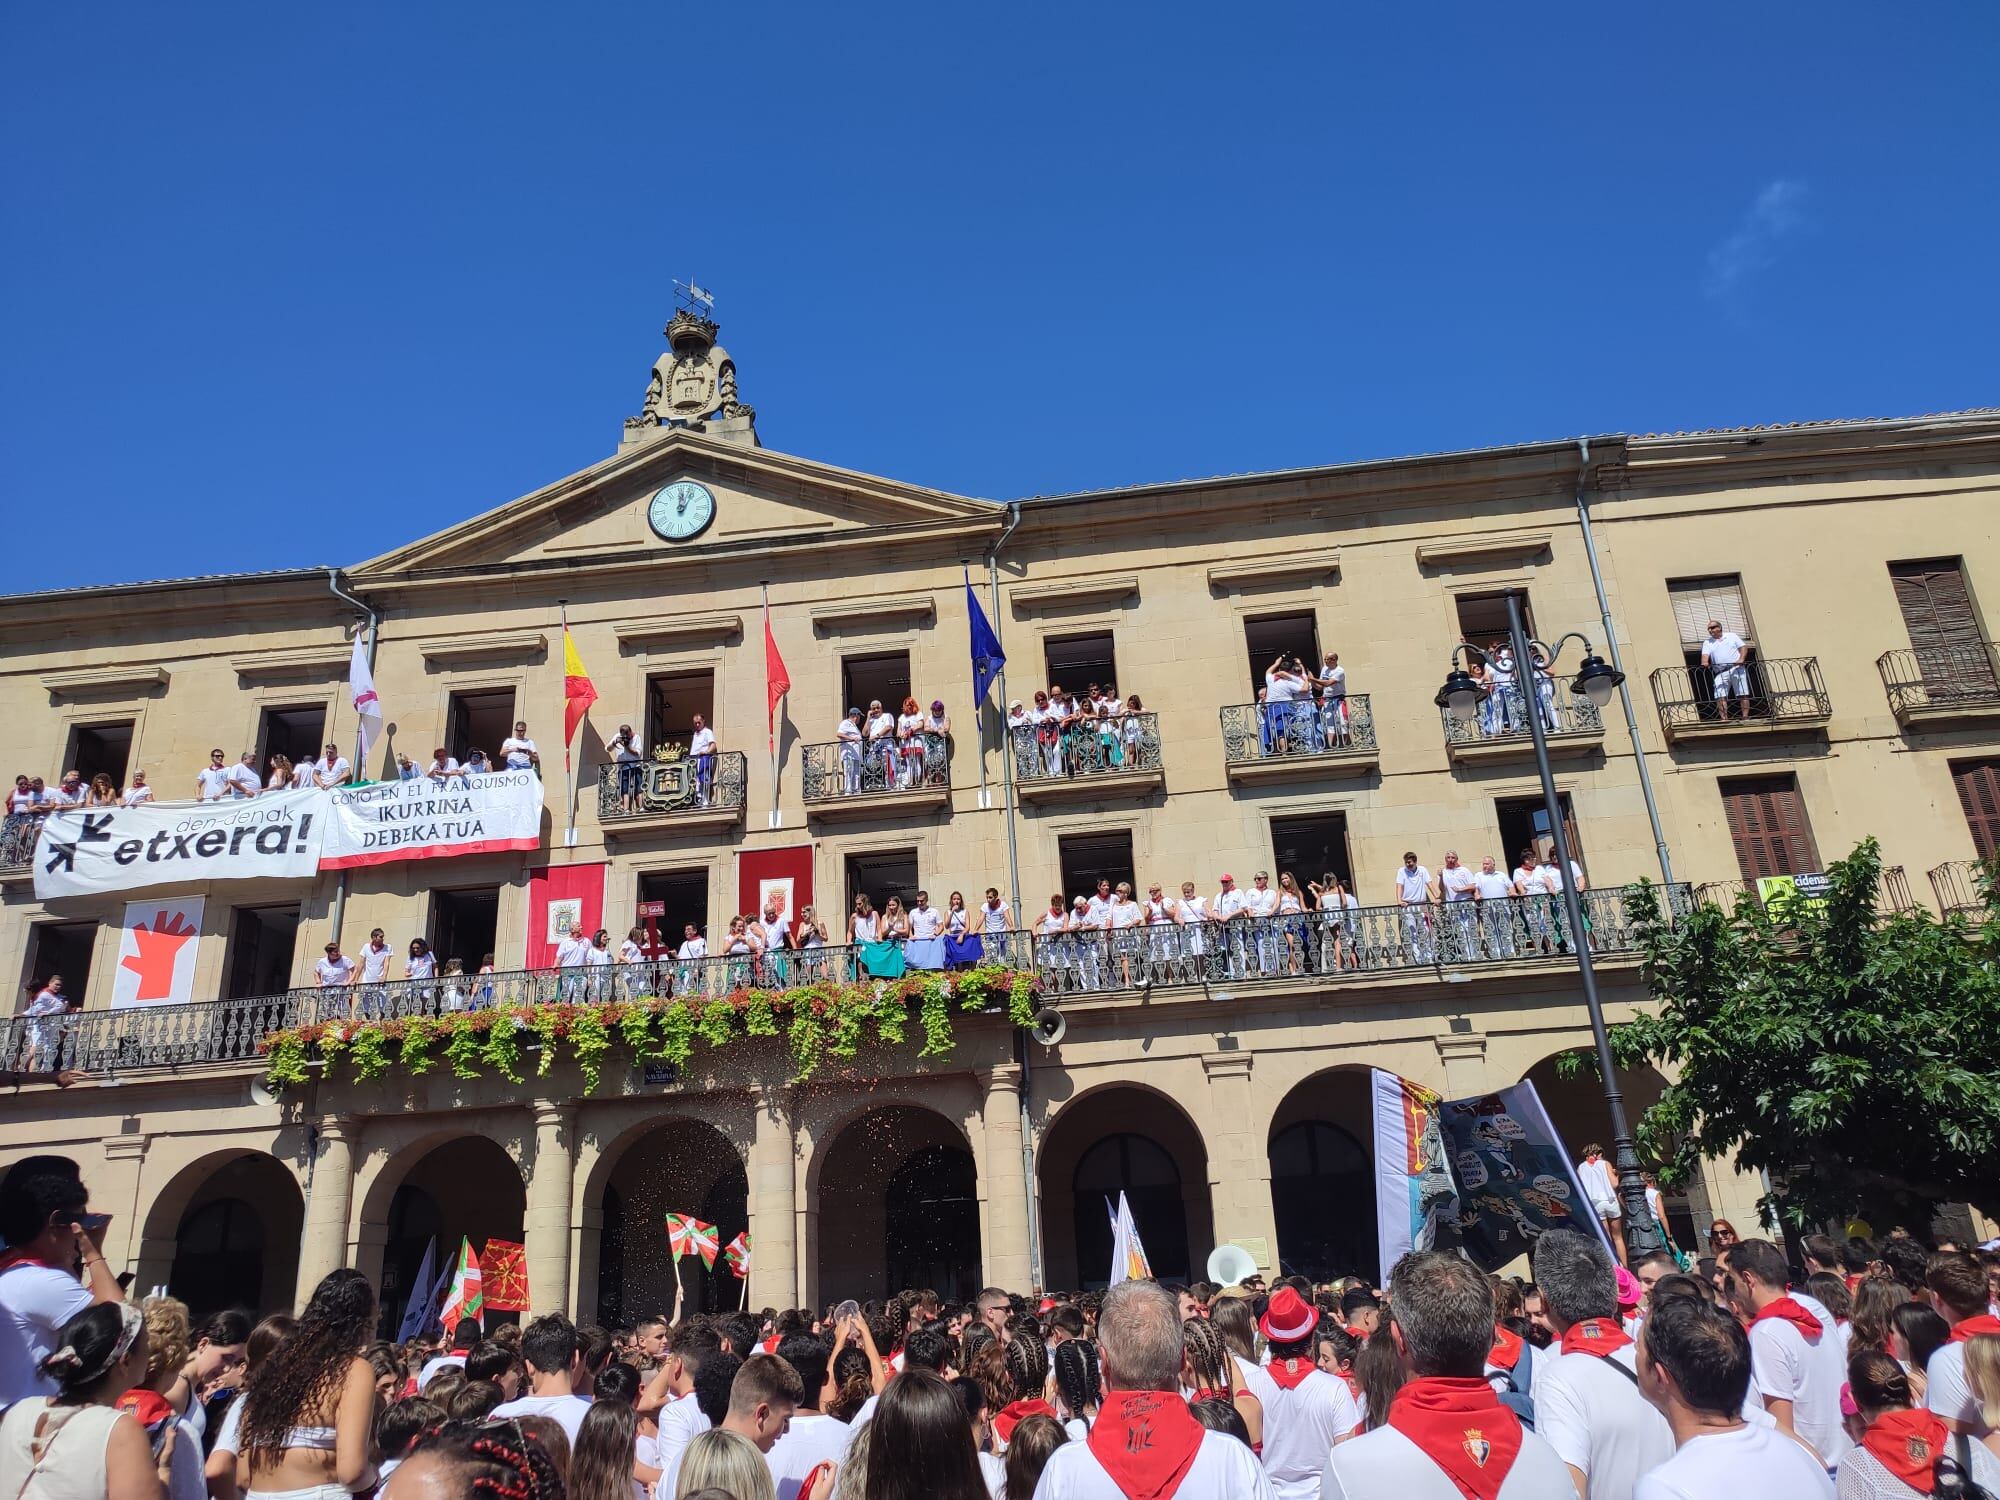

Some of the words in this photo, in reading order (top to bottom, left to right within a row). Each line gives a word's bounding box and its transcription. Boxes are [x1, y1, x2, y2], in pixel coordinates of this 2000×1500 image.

[331, 791, 372, 806] COMO
[381, 787, 400, 801] EN
[432, 774, 530, 794] FRANQUISMO
[176, 804, 296, 832] den-denak
[379, 797, 473, 822] IKURRIÑA
[113, 813, 314, 866] etxera!
[363, 820, 485, 848] DEBEKATUA
